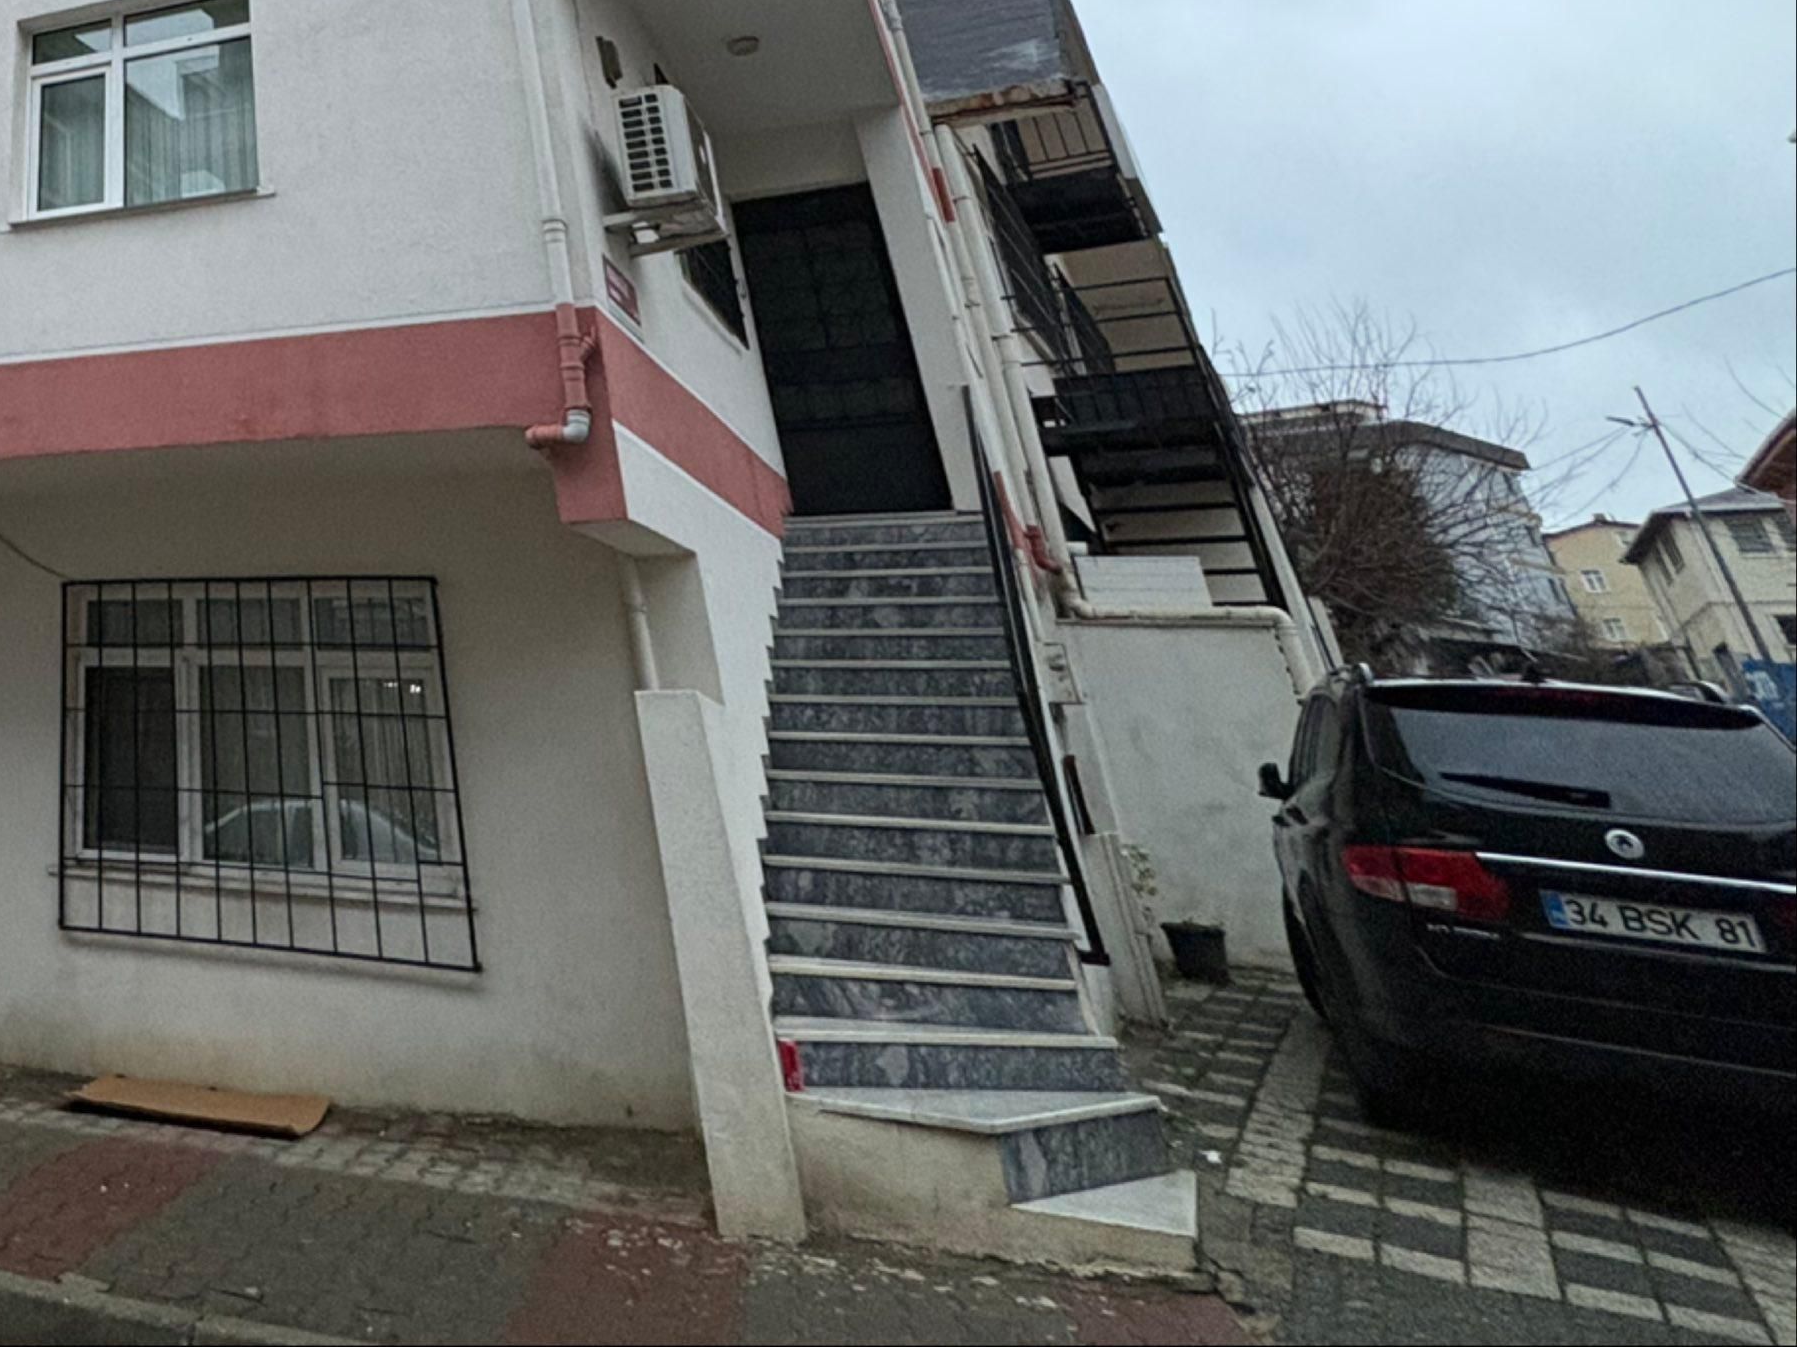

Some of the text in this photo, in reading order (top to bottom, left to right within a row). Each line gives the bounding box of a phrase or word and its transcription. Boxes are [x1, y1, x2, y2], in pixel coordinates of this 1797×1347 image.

[1565, 899, 1756, 948] 34 BSK 81
